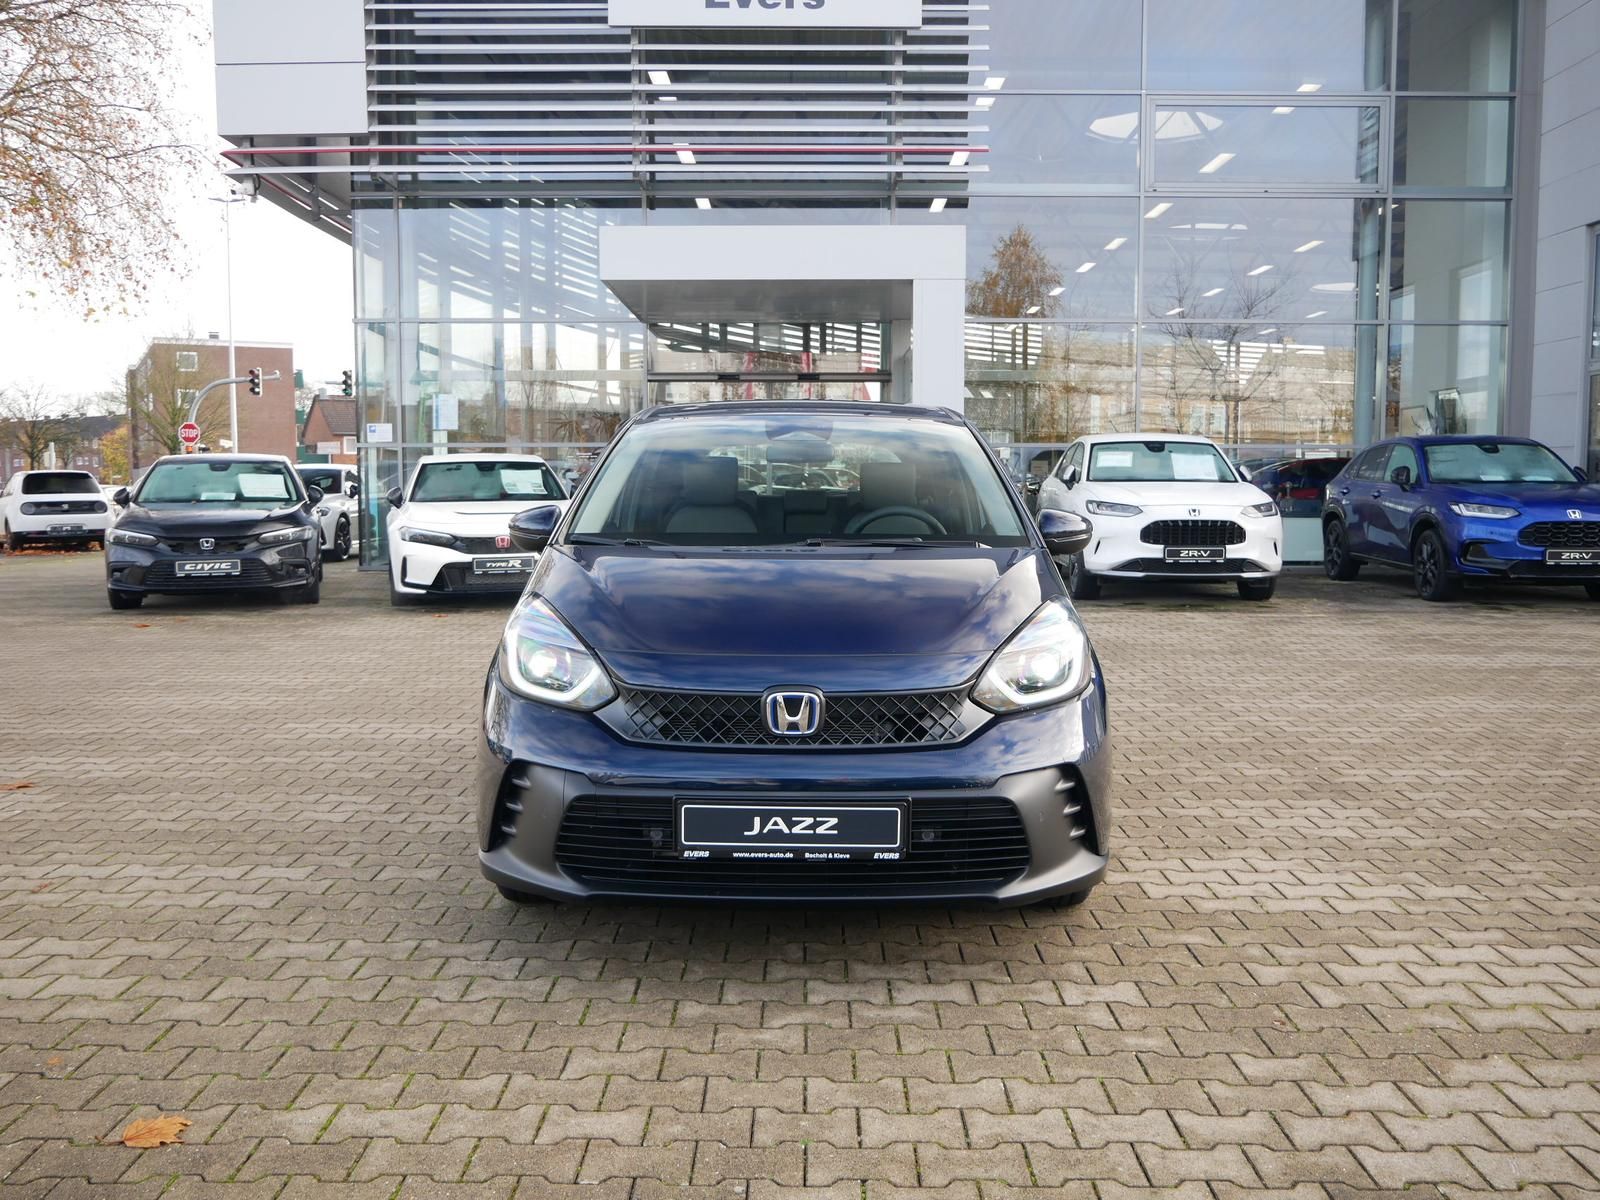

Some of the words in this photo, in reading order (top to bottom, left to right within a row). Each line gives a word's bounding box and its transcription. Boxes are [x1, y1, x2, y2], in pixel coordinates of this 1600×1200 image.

[181, 428, 198, 438] STOP
[184, 562, 232, 571] CIVIC
[743, 816, 839, 836] JAZZ
